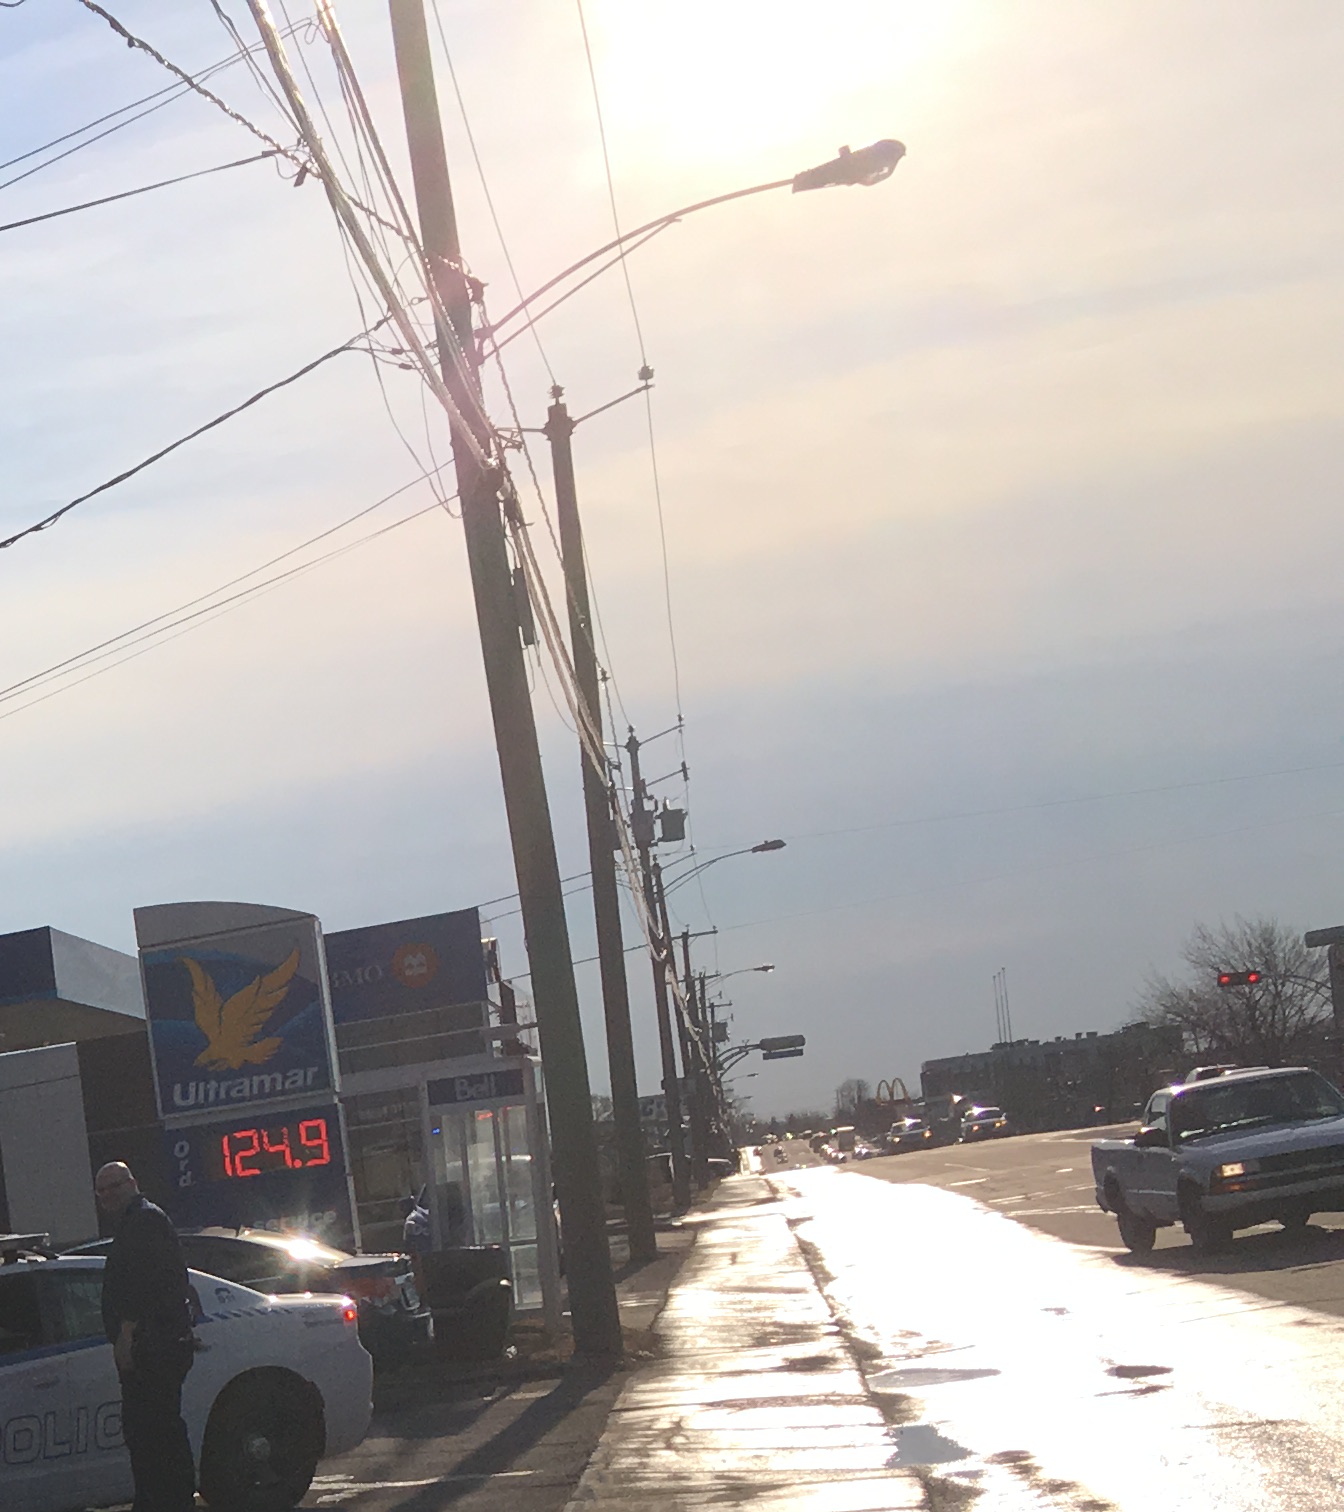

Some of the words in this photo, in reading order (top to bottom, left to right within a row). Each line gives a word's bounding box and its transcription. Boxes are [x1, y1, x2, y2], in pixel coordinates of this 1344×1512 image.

[172, 1065, 319, 1108] Ultramar
[454, 1073, 497, 1101] Bell
[222, 1119, 330, 1177] 124.9
